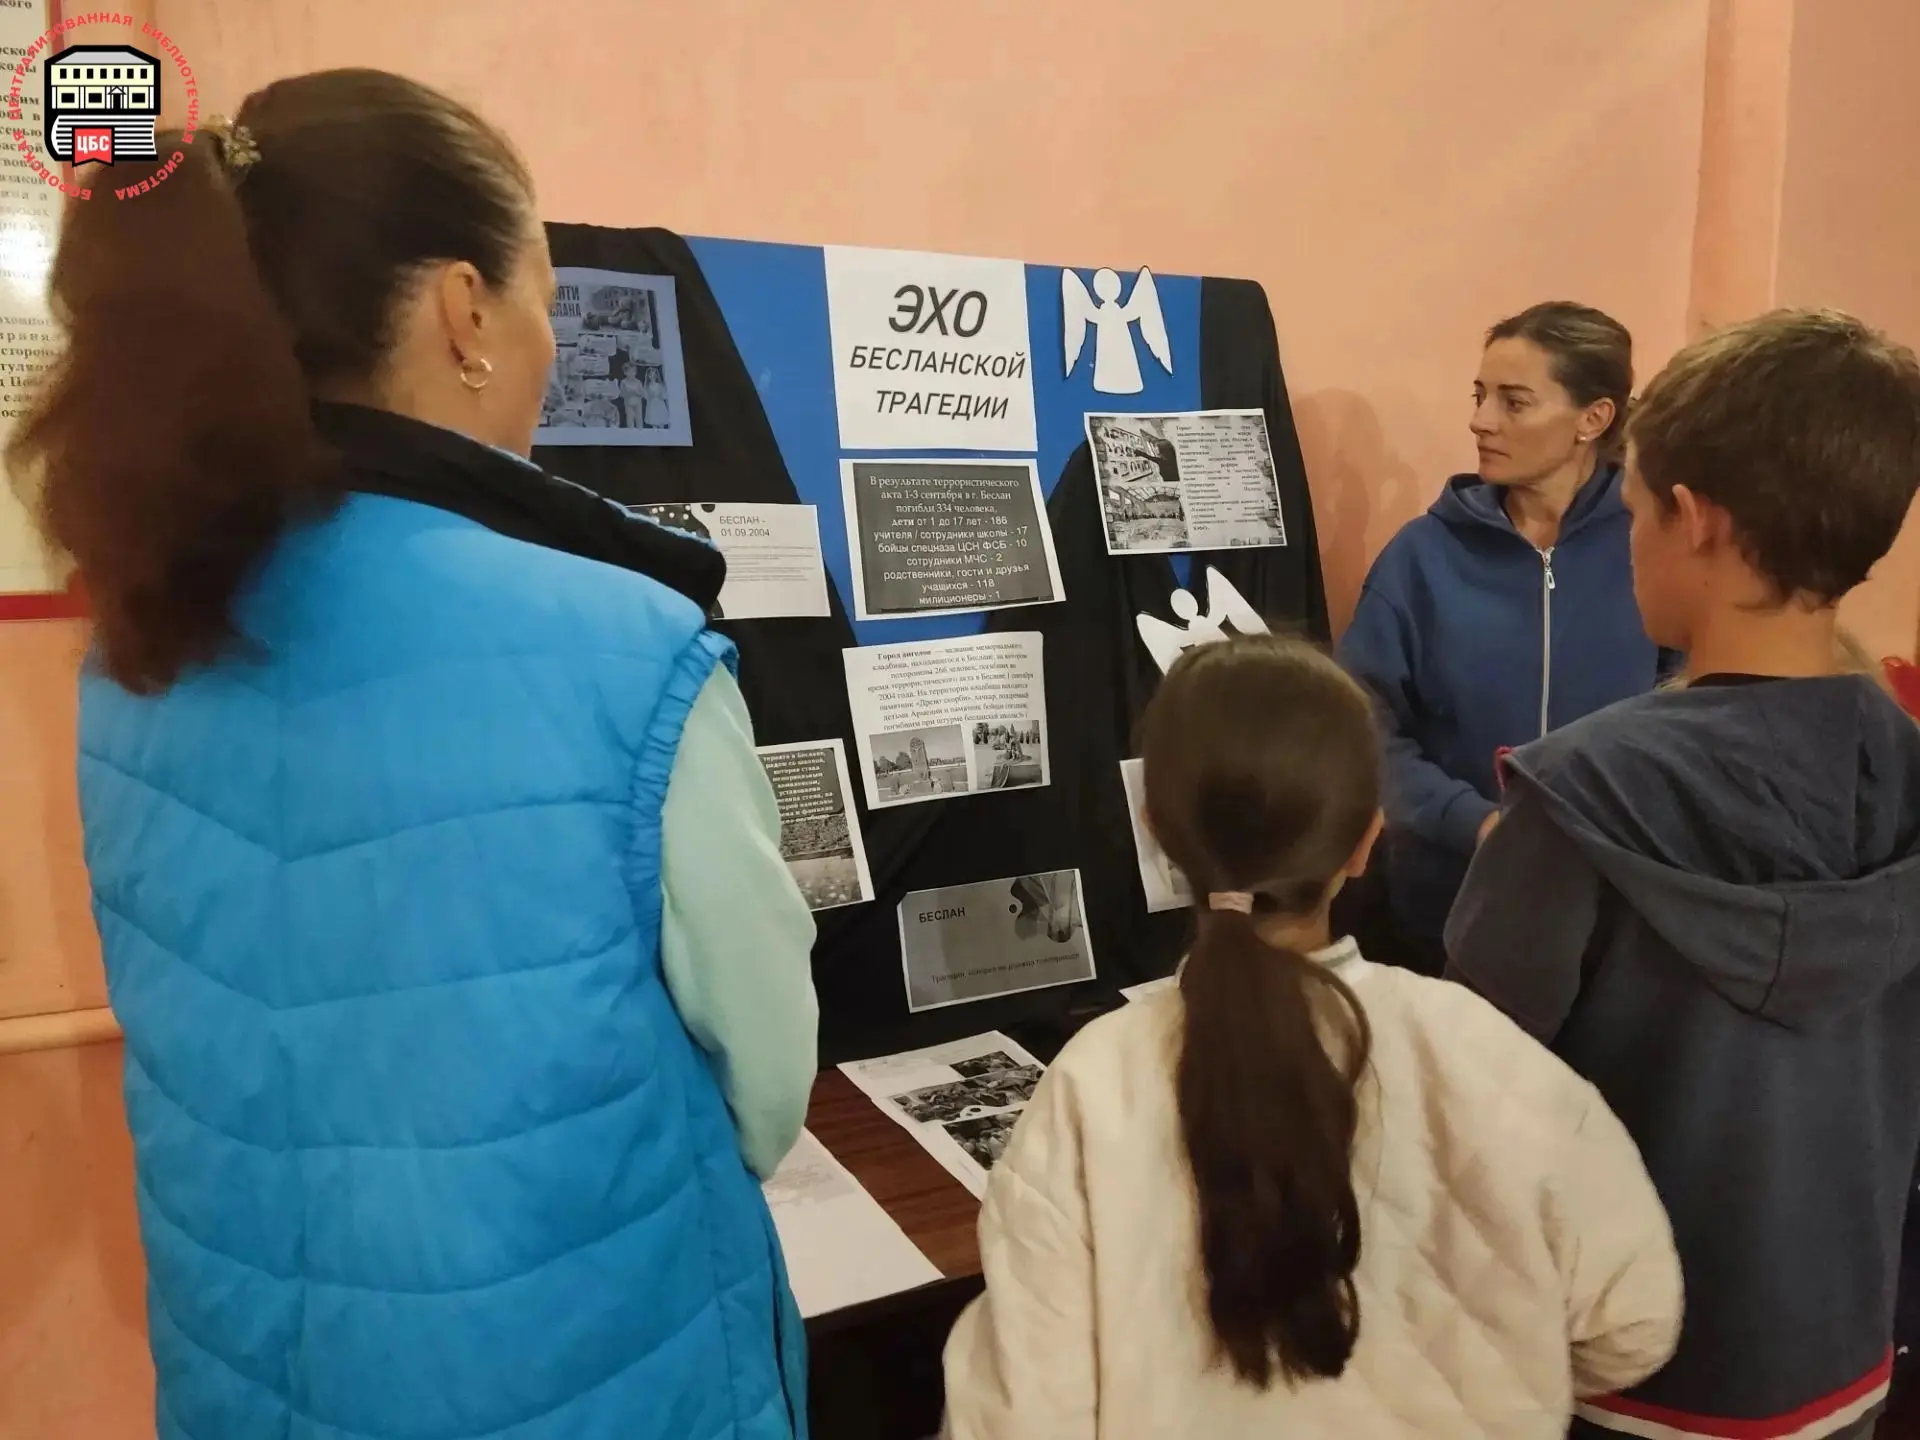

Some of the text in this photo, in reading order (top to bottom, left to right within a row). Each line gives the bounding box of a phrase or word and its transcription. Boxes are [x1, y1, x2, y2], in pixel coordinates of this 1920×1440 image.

[888, 284, 988, 337] ЭХО
[849, 345, 1026, 379] БЕСЛАНСКОЙ
[876, 390, 1009, 421] ТРАГЕДИИ
[870, 475, 1019, 488] В результате террористического
[881, 491, 902, 499] акта
[905, 489, 918, 499] 1-3
[920, 489, 962, 501] сентября
[981, 490, 1011, 500] Беслан
[896, 503, 935, 513] погибли
[936, 503, 951, 512] 334
[720, 515, 760, 525] БЕСЛАН
[892, 518, 914, 527] дети
[917, 518, 926, 526] от
[939, 518, 950, 527] до
[953, 516, 963, 526] 17
[966, 518, 981, 526] лет
[721, 528, 770, 538] 01.09.2004
[874, 531, 912, 541] учителя
[920, 530, 975, 541] сотрудники
[977, 530, 1008, 539] школы
[1016, 526, 1027, 535] 17
[878, 542, 908, 553] бойцы
[911, 544, 955, 553] спецназа
[957, 541, 980, 552] ЦСН
[982, 540, 1007, 550] ФСБ
[1016, 538, 1027, 548] 10
[906, 557, 963, 568] сотрудники
[964, 554, 988, 564] МЧС
[996, 553, 1003, 562] 2
[883, 569, 955, 582] родственники,
[957, 568, 984, 577] гости
[995, 564, 1030, 576] друзья
[921, 582, 968, 594] учащихся
[919, 593, 987, 605] милиционеры
[919, 906, 966, 924] БЕСЛАН
